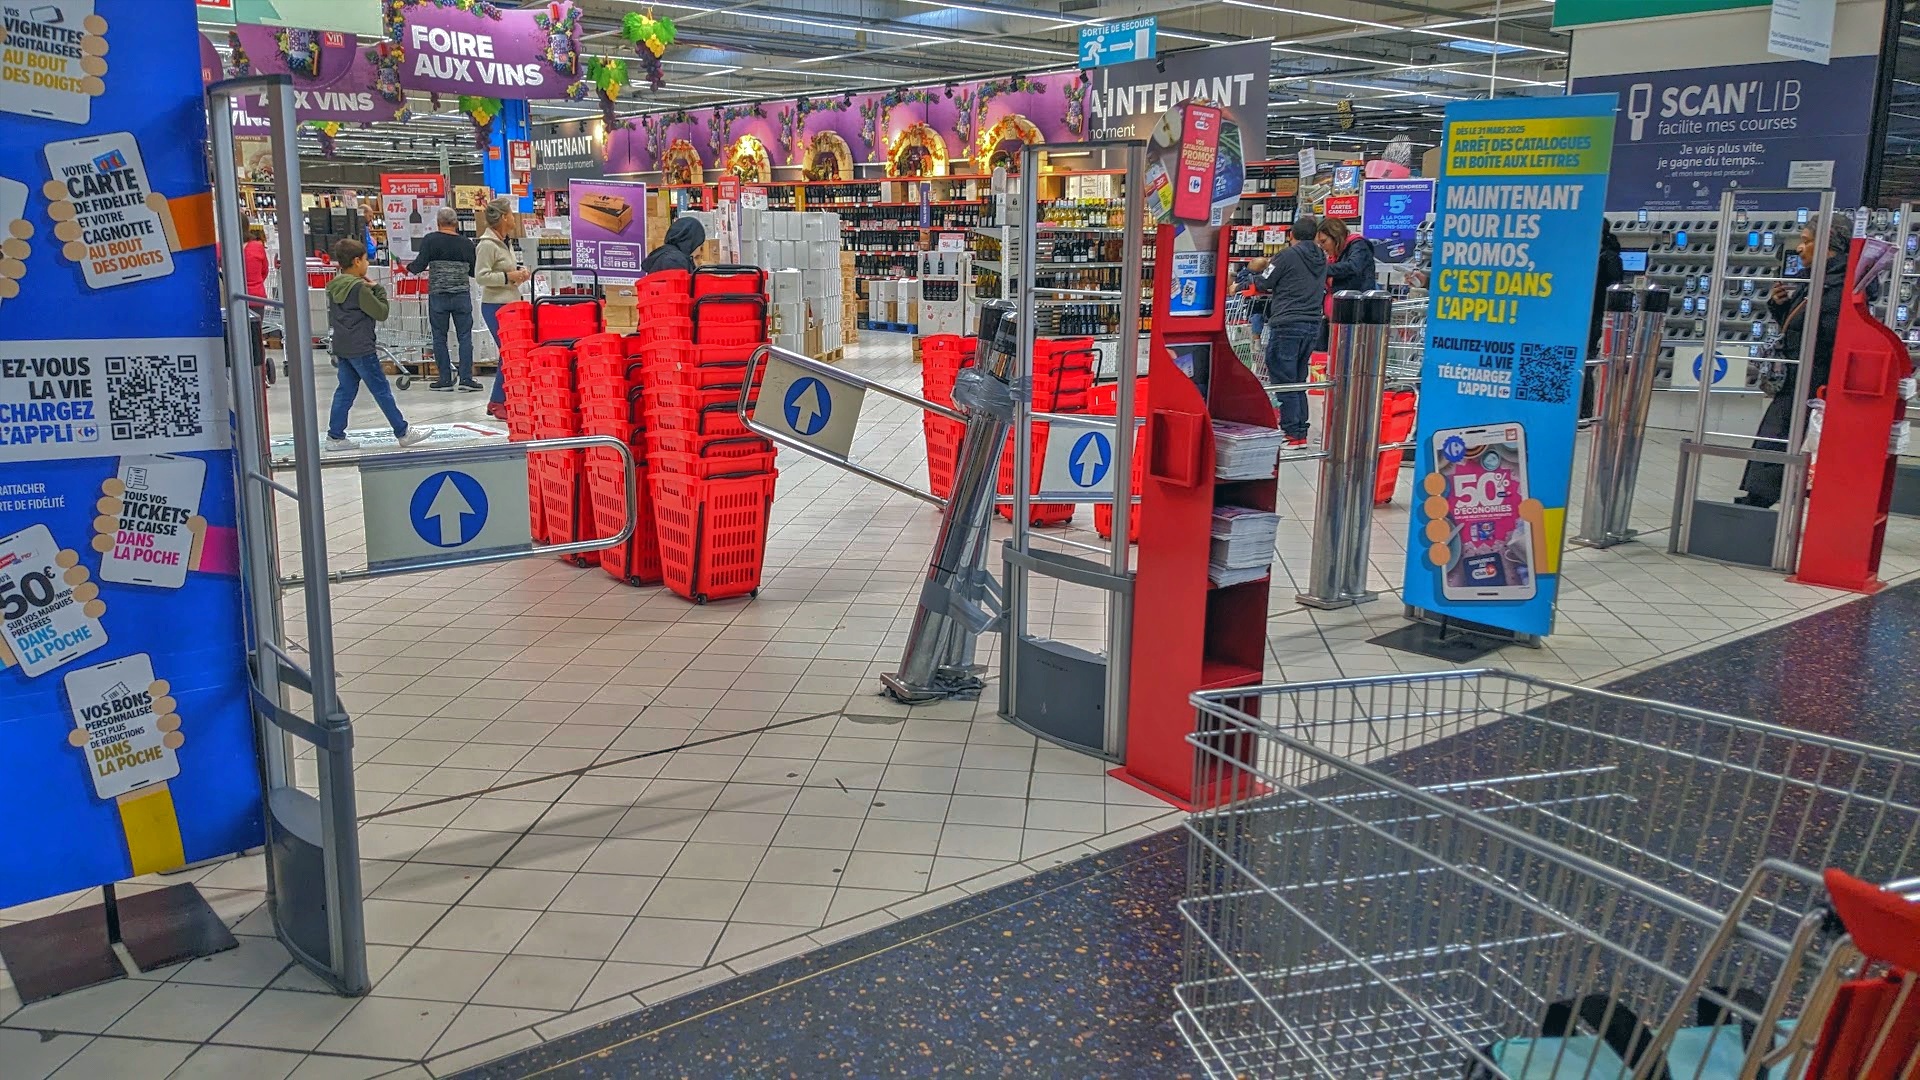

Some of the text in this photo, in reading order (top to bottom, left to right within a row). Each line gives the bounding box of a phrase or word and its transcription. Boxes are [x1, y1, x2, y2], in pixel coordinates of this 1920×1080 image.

[4, 6, 19, 17] VOS
[4, 17, 84, 45] VIGNETTES
[1082, 17, 1155, 38] SORTIE DE SECOURS
[411, 24, 495, 60] FOIRE
[3, 48, 68, 73] AU BOUT
[414, 53, 544, 87] AUX VINS
[3, 66, 83, 94] DES DOIGTS
[314, 92, 374, 112] VINS
[1090, 73, 1254, 118] AINTENANT
[1659, 79, 1802, 118] SCAN'LIB
[1469, 127, 1477, 135] LE
[1657, 117, 1798, 136] facilite mes courses
[1453, 136, 1592, 152] ARRÊT DES CATALOGUES
[1680, 142, 1766, 156] Je vais plus vite,
[567, 160, 574, 169] du
[1182, 148, 1215, 163] PROMOS
[1453, 152, 1580, 168] EN BOÎTE AUX LETTRES
[1656, 156, 1765, 170] je gagne du temps...
[61, 163, 94, 177] VOTRE
[1671, 170, 1678, 178] et
[1694, 170, 1713, 178] temps
[1713, 169, 1723, 177] est
[67, 168, 138, 199] CARTE
[73, 187, 146, 214] DE FIDÉLITÉ
[1446, 185, 1584, 210] MAINTENANT
[77, 211, 125, 228] ET VOTRE
[1443, 213, 1542, 239] POUR LES
[83, 219, 154, 245] CAGNOTTE
[89, 238, 144, 260] AU BOUT
[1441, 241, 1536, 272] PROMOS,
[92, 249, 164, 276] DES DOIGTS
[1439, 268, 1553, 298] C'EST DANS
[1436, 295, 1506, 324] L'APPLI
[1432, 336, 1515, 355] FACILITEZ-VOUS
[1438, 362, 1512, 384] TÉLÉCHARGEZ
[1479, 355, 1514, 370] LA VIE
[29, 379, 93, 400] LA VIE
[1457, 381, 1497, 398] L'APPLI
[15, 500, 27, 511] DE
[28, 495, 65, 510] FIDÉLITÉ
[124, 491, 168, 505] TOUS VOS
[122, 501, 191, 525] TICKETS
[119, 519, 178, 536] DE CAISSE
[116, 531, 155, 548] DANS
[113, 546, 180, 566] LA POCHE
[7, 596, 74, 631] SUR VOS MARQUES
[16, 624, 58, 652] DANS
[24, 624, 93, 665] LA POCHE
[80, 690, 153, 721] VOS BONS
[90, 725, 145, 750] DE RÉDUCTIONS
[108, 722, 127, 736] PLUS
[94, 740, 132, 763] DANS
[98, 745, 164, 778] LA POCHE
